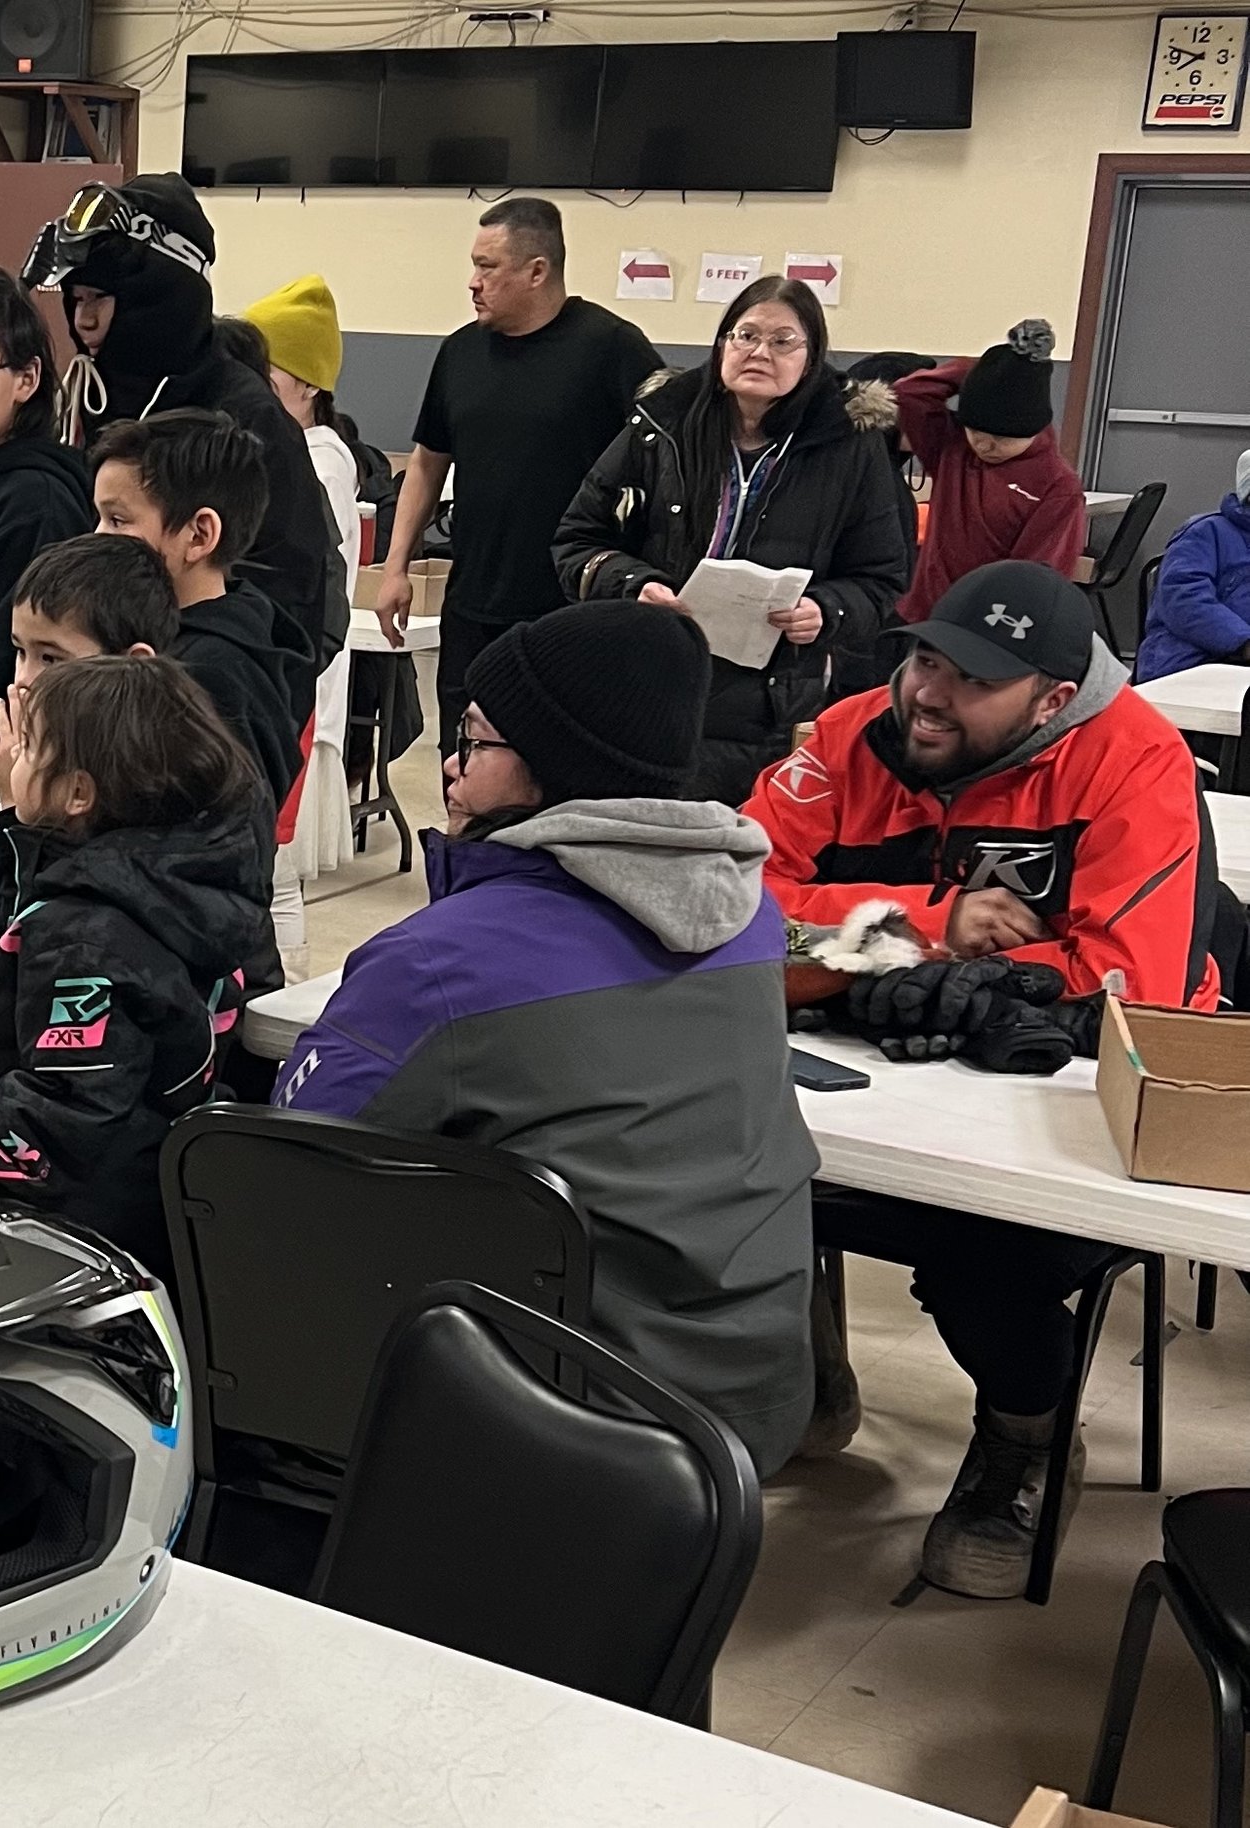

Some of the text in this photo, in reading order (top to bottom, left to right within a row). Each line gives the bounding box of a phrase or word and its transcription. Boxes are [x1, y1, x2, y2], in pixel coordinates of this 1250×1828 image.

[1192, 27, 1211, 43] 12
[1168, 50, 1181, 65] 9
[1216, 49, 1229, 64] 3
[1189, 70, 1202, 85] 6
[1159, 94, 1227, 106] PEPSI
[705, 268, 749, 281] 6 FEET
[0, 1598, 121, 1658] FLY RACING
